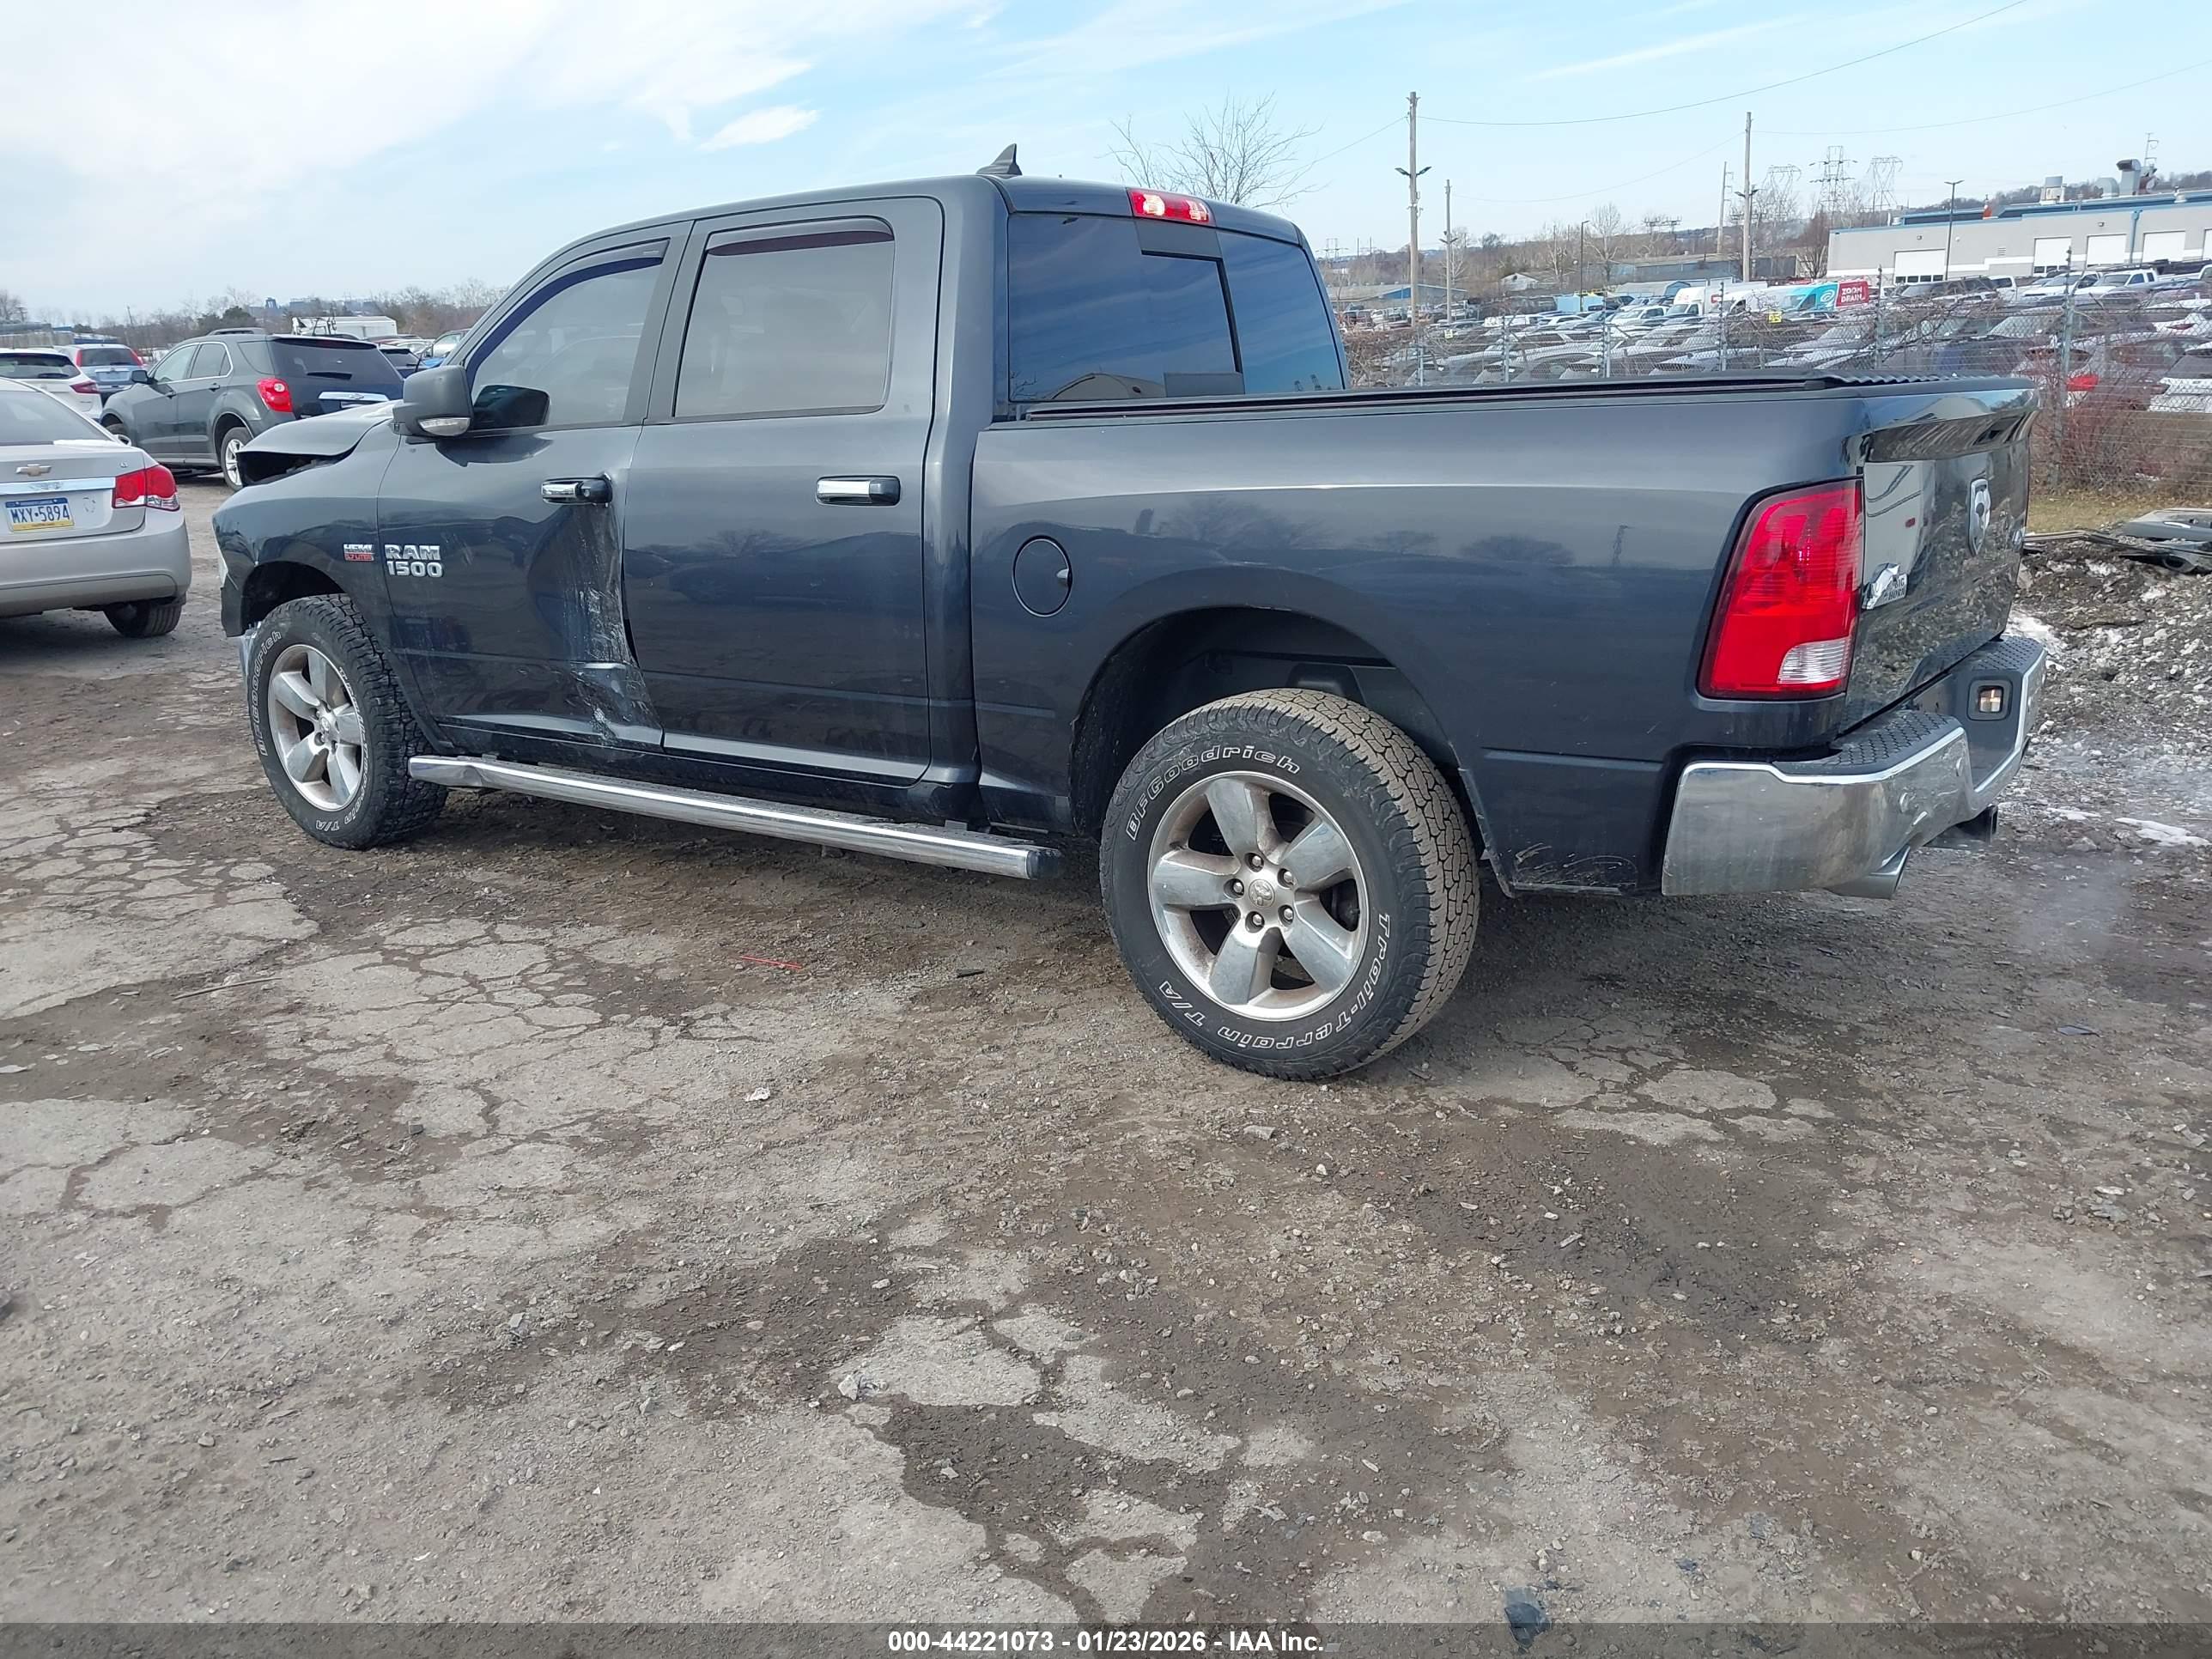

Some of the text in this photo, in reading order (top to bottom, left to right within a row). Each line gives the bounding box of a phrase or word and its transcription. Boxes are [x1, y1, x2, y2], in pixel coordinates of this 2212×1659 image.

[1841, 286, 1863, 296] ZOOM
[384, 544, 441, 561] RAM
[386, 561, 443, 578] 1500
[1126, 744, 1300, 841] BFGoodrich
[1159, 913, 1390, 1049] Trail-Terrain T/A
